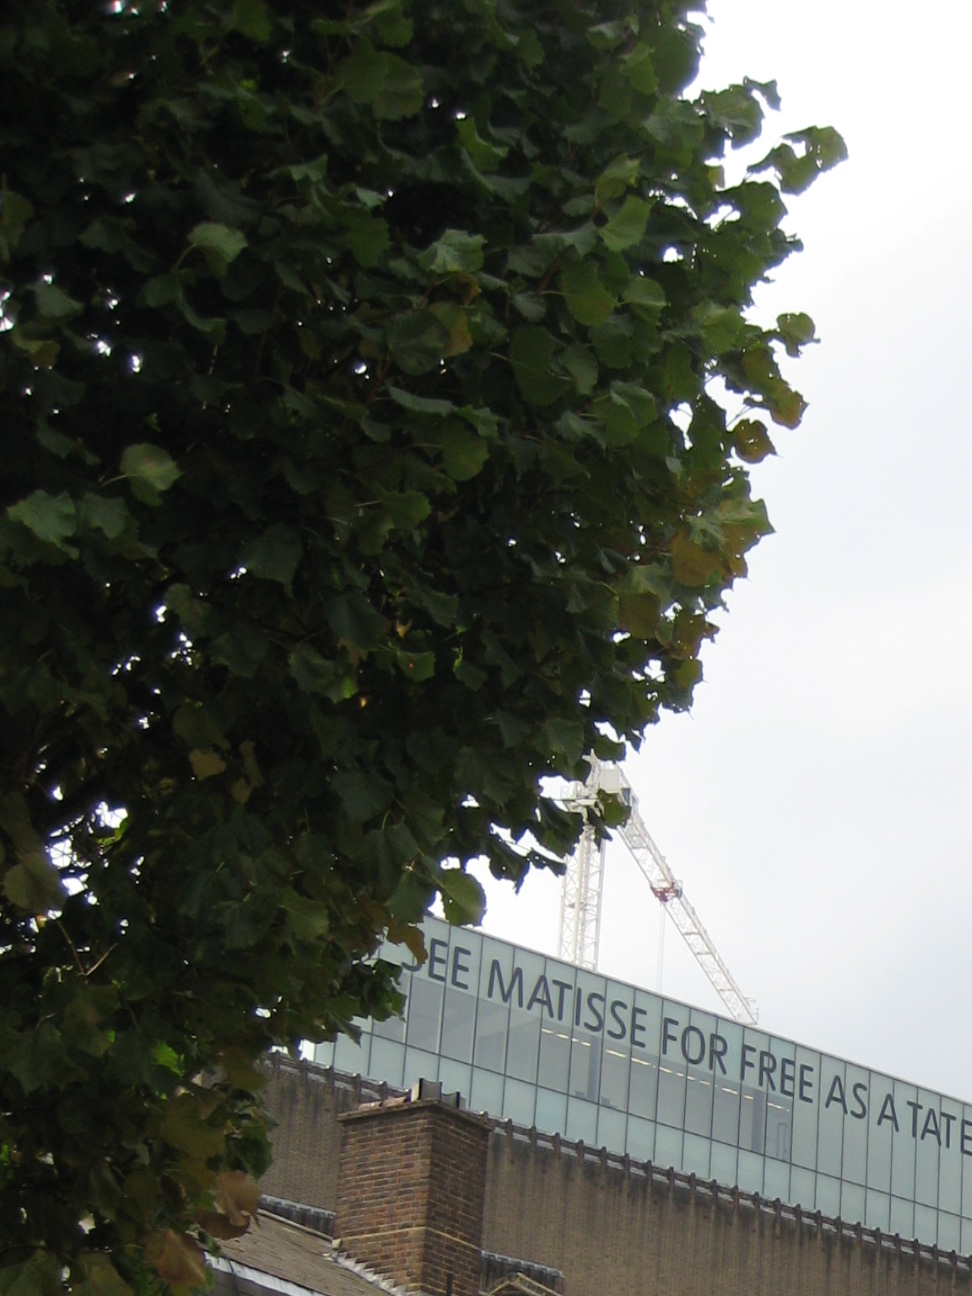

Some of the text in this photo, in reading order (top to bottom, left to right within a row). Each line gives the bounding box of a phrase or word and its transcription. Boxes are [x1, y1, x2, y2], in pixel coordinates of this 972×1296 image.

[487, 959, 647, 1049] MATISSE
[662, 1017, 727, 1076] FOR
[740, 1043, 814, 1105] FREE
[825, 1074, 867, 1119] AS
[877, 1093, 899, 1132] A
[906, 1100, 972, 1156] TATE
